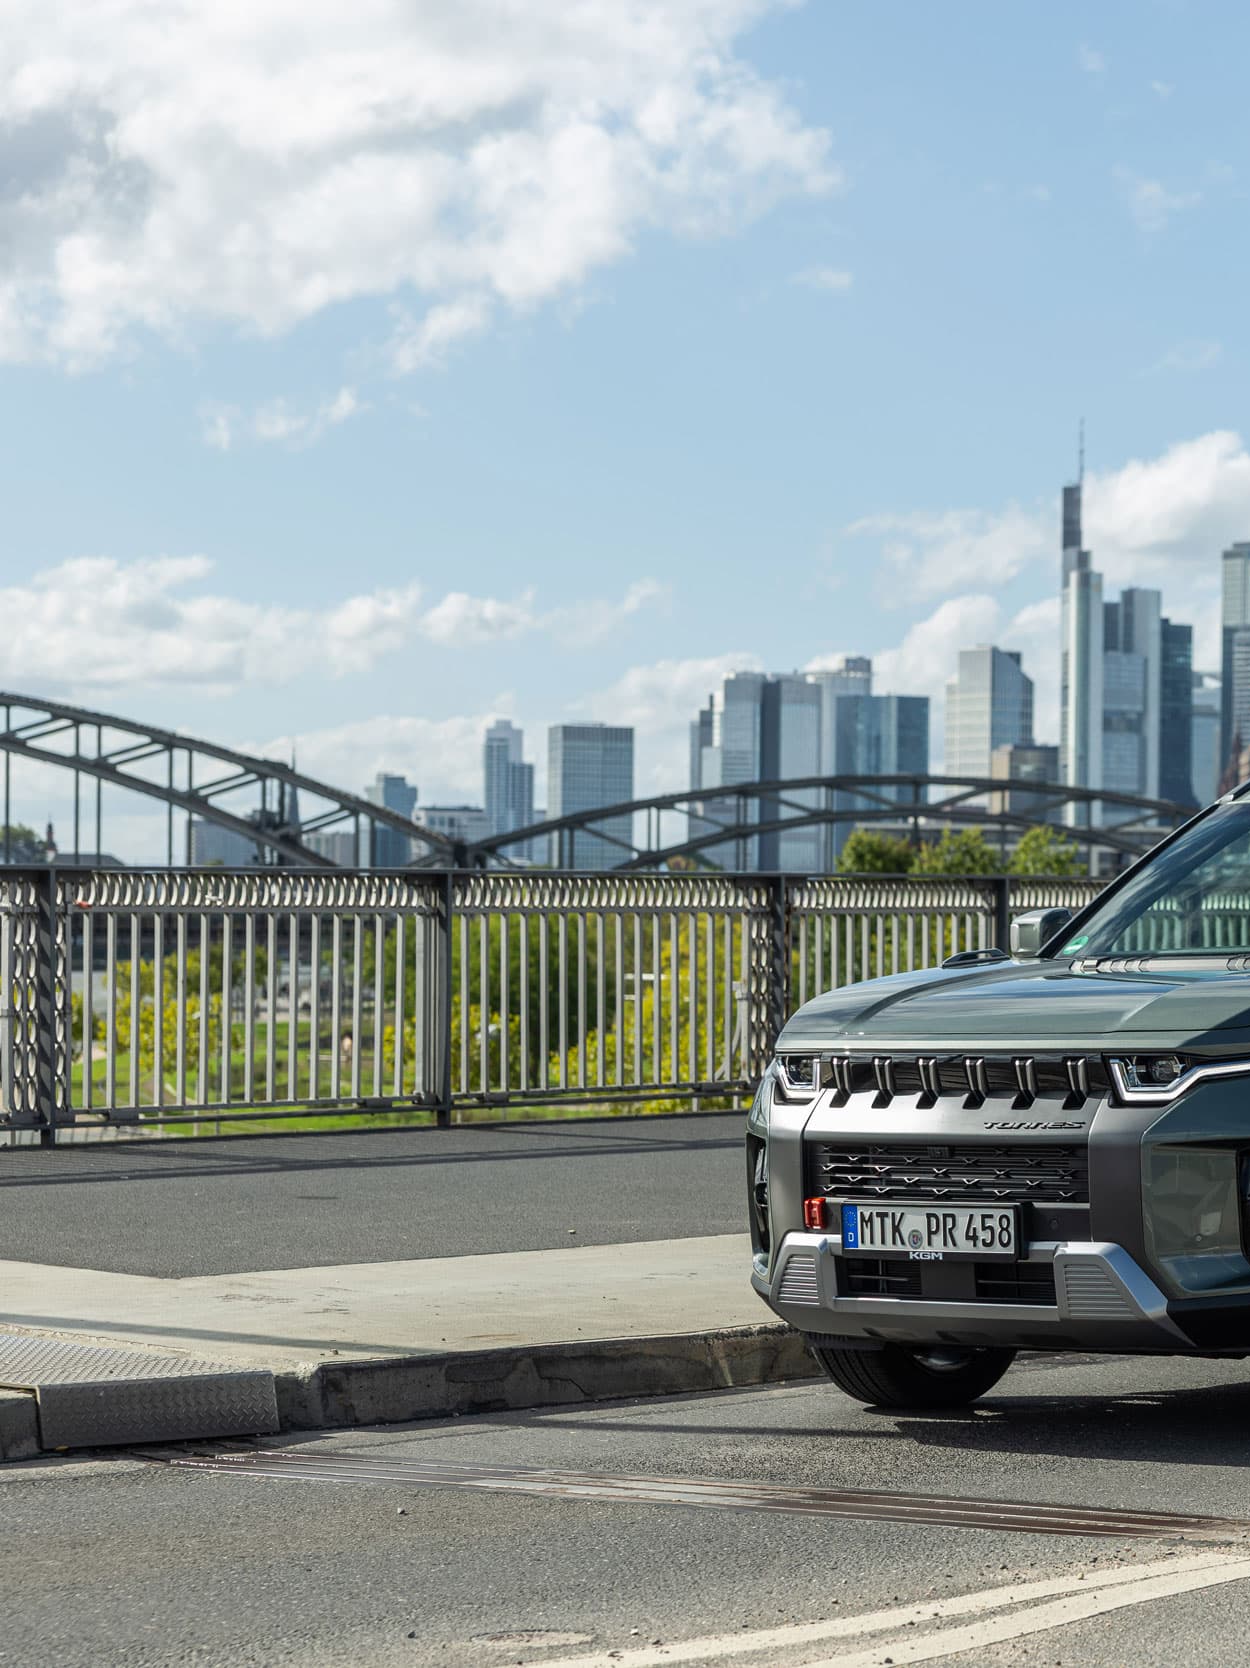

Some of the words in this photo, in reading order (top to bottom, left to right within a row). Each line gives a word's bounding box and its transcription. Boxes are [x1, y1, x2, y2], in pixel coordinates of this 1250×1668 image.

[984, 1121, 1086, 1130] TORRES
[859, 1211, 906, 1246] MTK
[925, 1212, 957, 1247] PR
[964, 1213, 1012, 1248] 458
[847, 1232, 855, 1242] D
[909, 1251, 943, 1260] KGM
